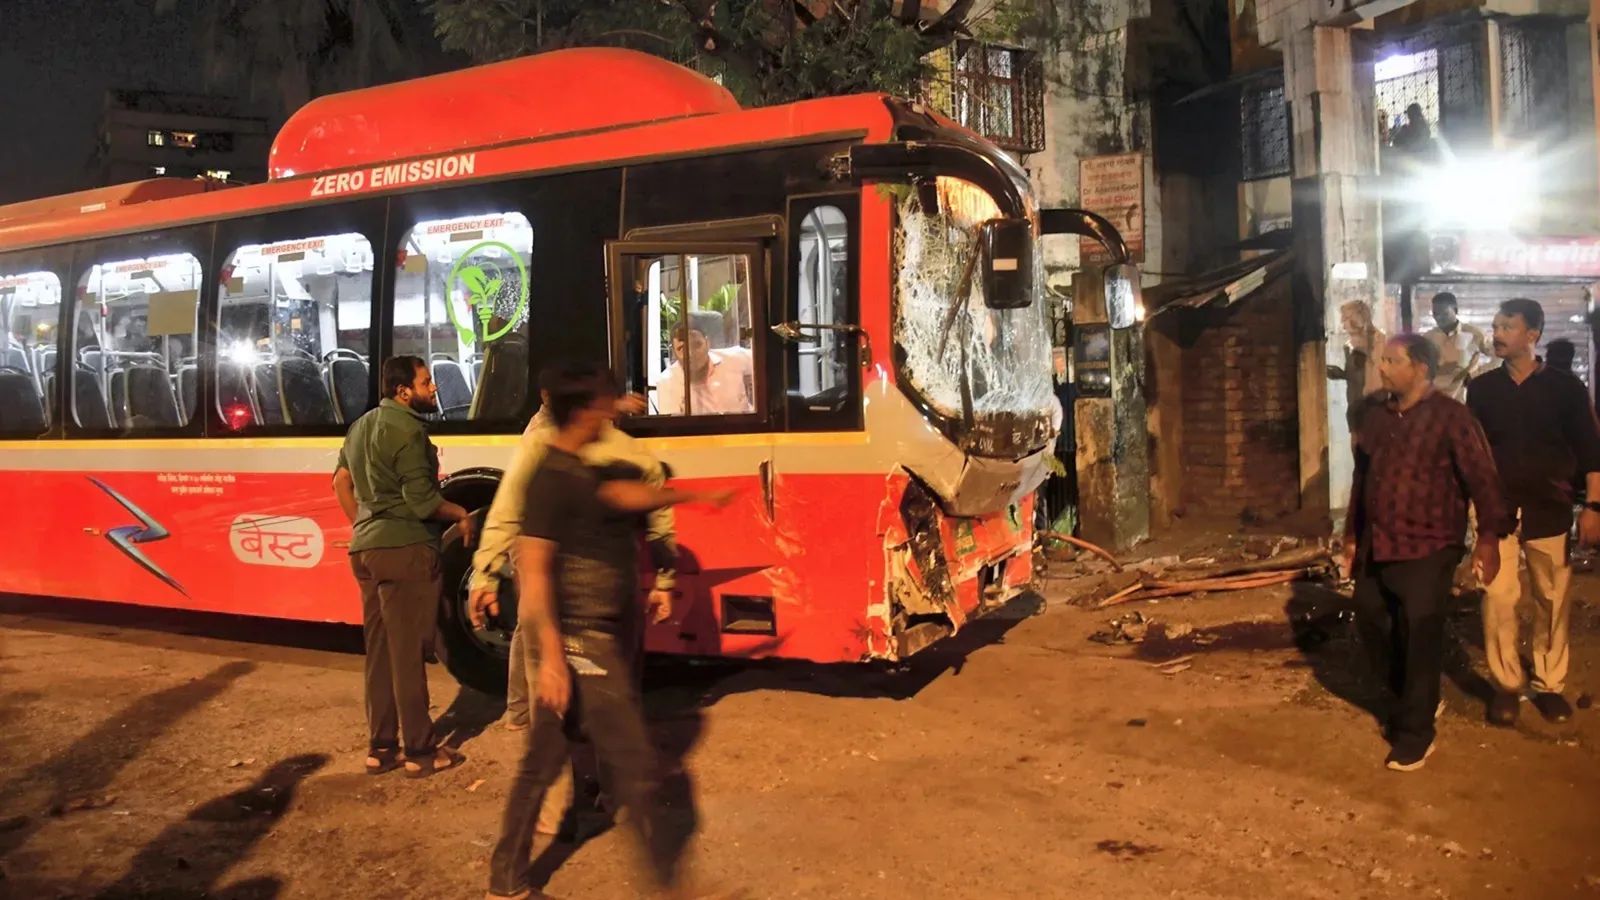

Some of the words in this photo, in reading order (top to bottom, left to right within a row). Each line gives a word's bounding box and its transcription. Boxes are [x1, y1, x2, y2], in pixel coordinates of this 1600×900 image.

[311, 172, 364, 196] ZERO
[370, 153, 475, 187] EMISSION
[427, 222, 481, 235] EMERGENCY
[484, 218, 504, 228] EXIT
[261, 243, 306, 256] EMERGENCY
[307, 239, 325, 250] EXIT
[238, 518, 315, 562] बेस्ट
